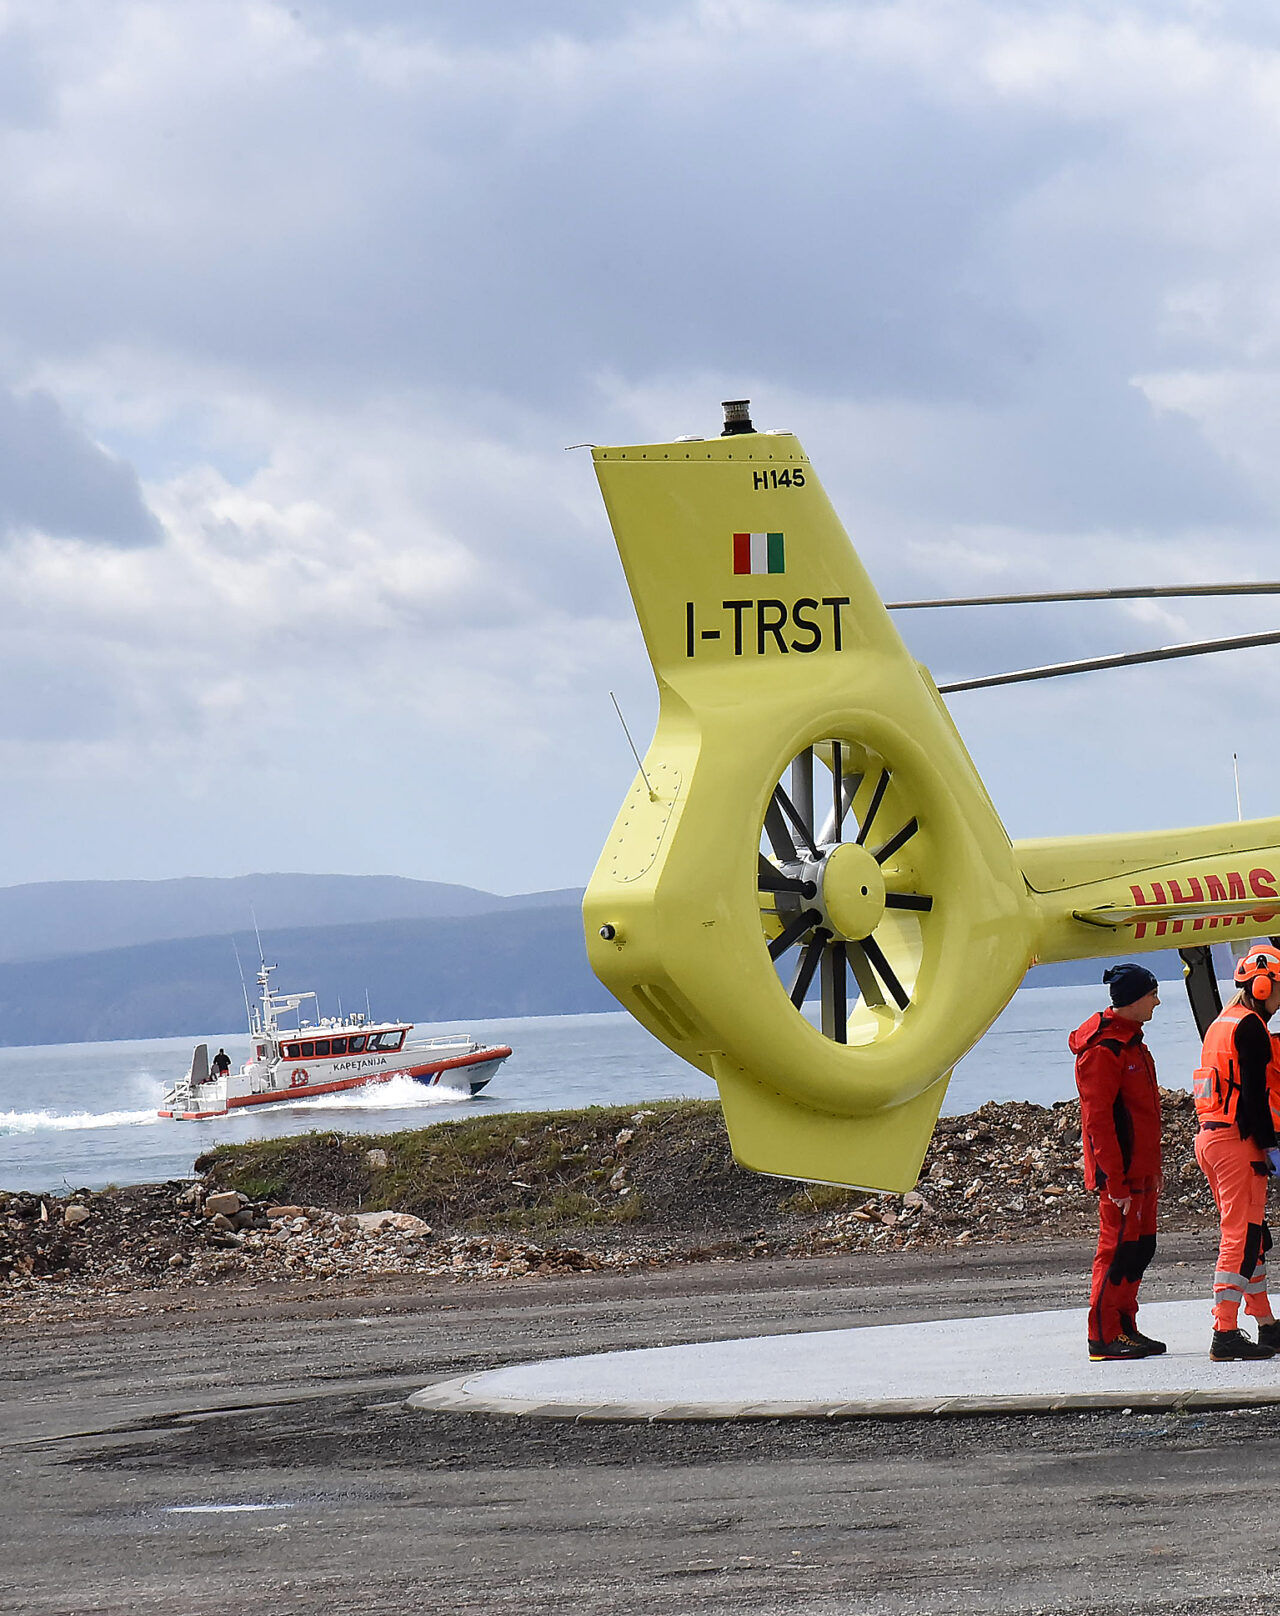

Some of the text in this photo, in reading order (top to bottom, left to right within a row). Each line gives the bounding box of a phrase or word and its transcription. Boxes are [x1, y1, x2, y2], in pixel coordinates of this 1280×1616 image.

[753, 468, 806, 491] H145
[686, 597, 850, 657] I-TRST
[1129, 868, 1279, 939] HHMS
[333, 1057, 387, 1071] KAPETANIJA
